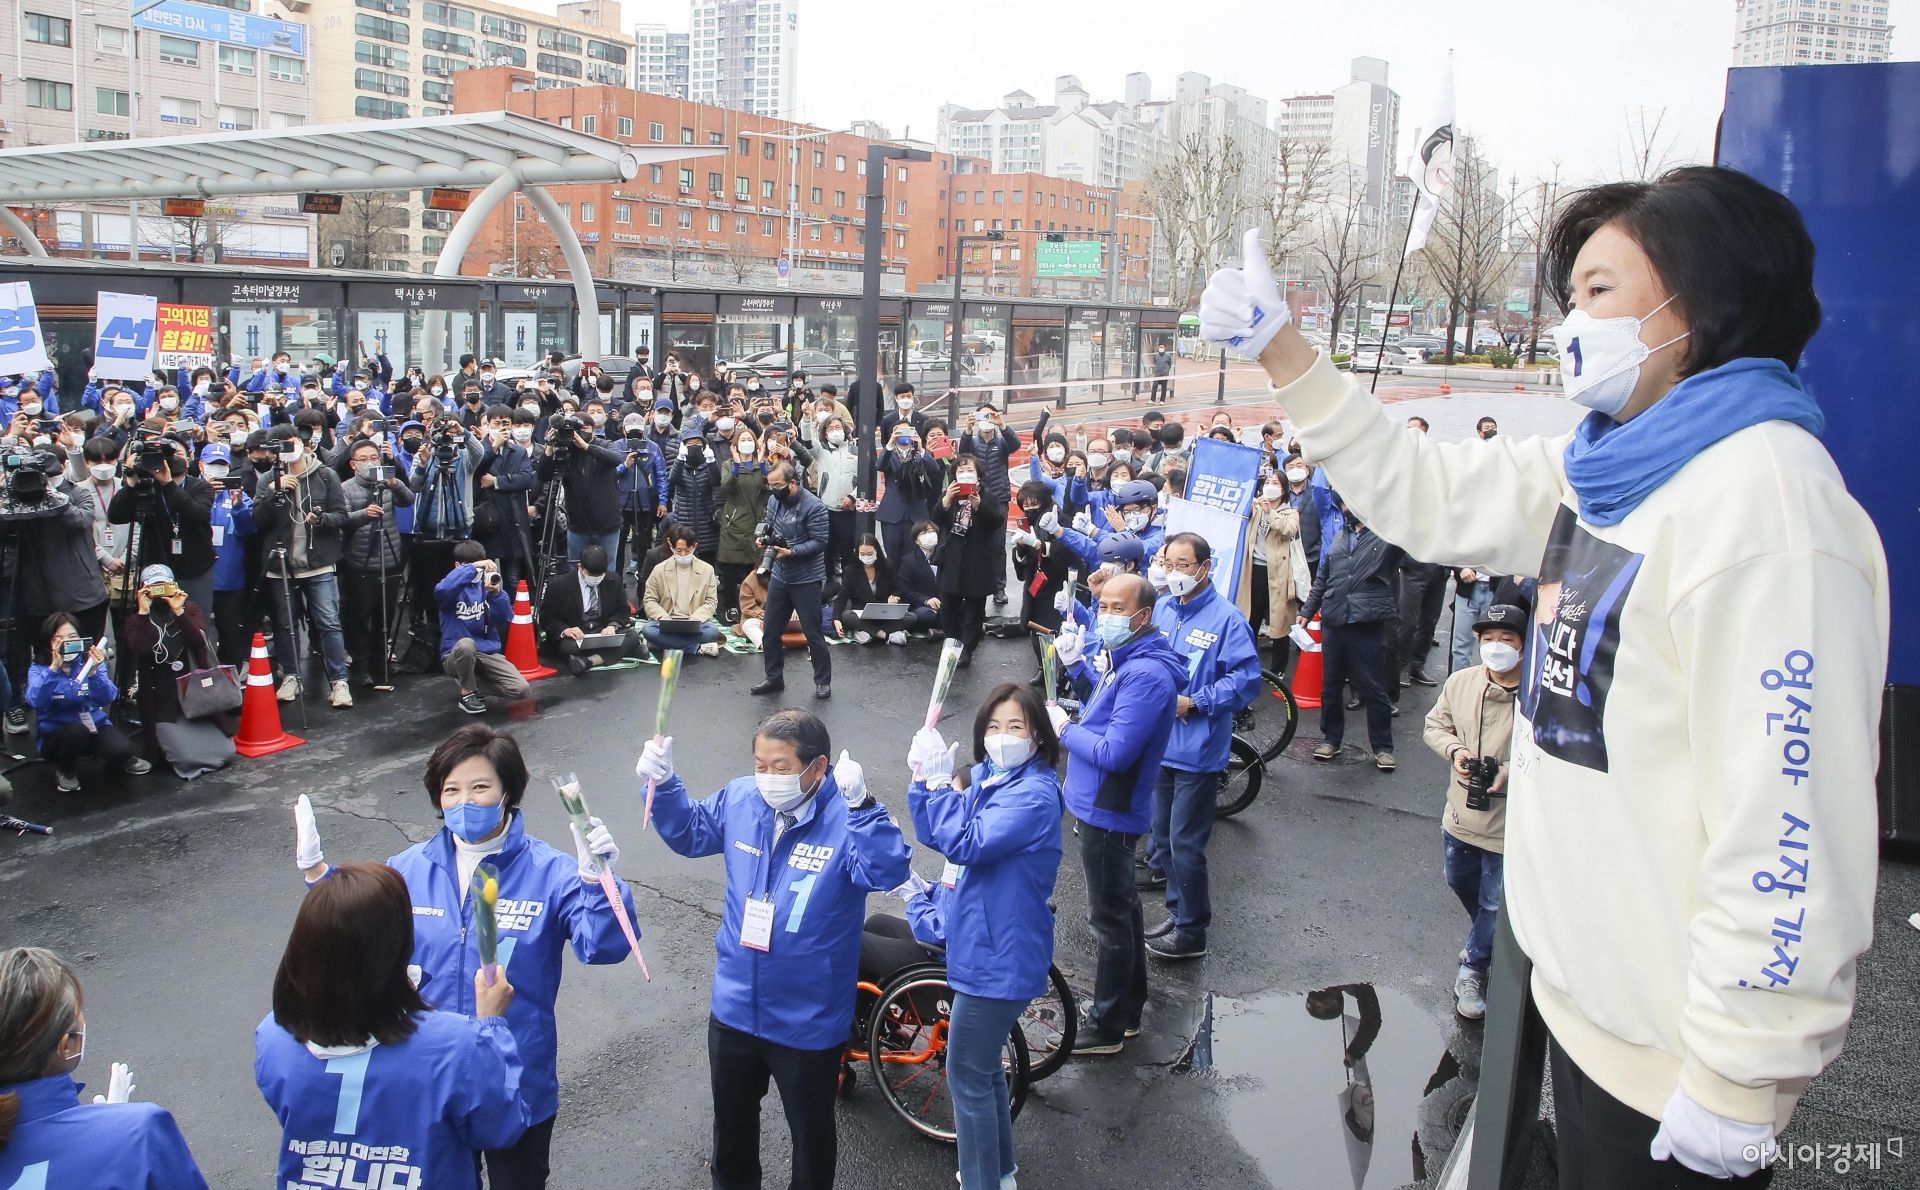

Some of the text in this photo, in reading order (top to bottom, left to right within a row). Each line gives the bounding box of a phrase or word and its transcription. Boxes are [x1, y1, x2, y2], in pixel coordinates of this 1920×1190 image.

[142, 9, 183, 27] 대한민국
[1369, 103, 1383, 148] DongAh
[332, 248, 344, 257] TAXI
[232, 284, 300, 297] 고속터미널경부선
[394, 288, 437, 301] 택시승차
[523, 288, 548, 297] 택시승차
[820, 301, 842, 310] 택시승차
[159, 306, 209, 328] 구역지정
[95, 316, 156, 361] 선
[161, 330, 209, 352] 철회!!
[1566, 336, 1583, 378] 1
[1191, 479, 1243, 501] 합니다
[1178, 581, 1184, 591] 1
[1190, 628, 1219, 643] 합니다
[1759, 648, 1814, 786] 영선아
[792, 842, 834, 860] 합니다
[1751, 811, 1811, 900] 시장
[496, 898, 544, 917] 합니다
[784, 873, 818, 934] 1
[325, 1049, 373, 1136] 1
[288, 1139, 410, 1162] 서울시 대전환
[301, 1155, 422, 1190] 합니다
